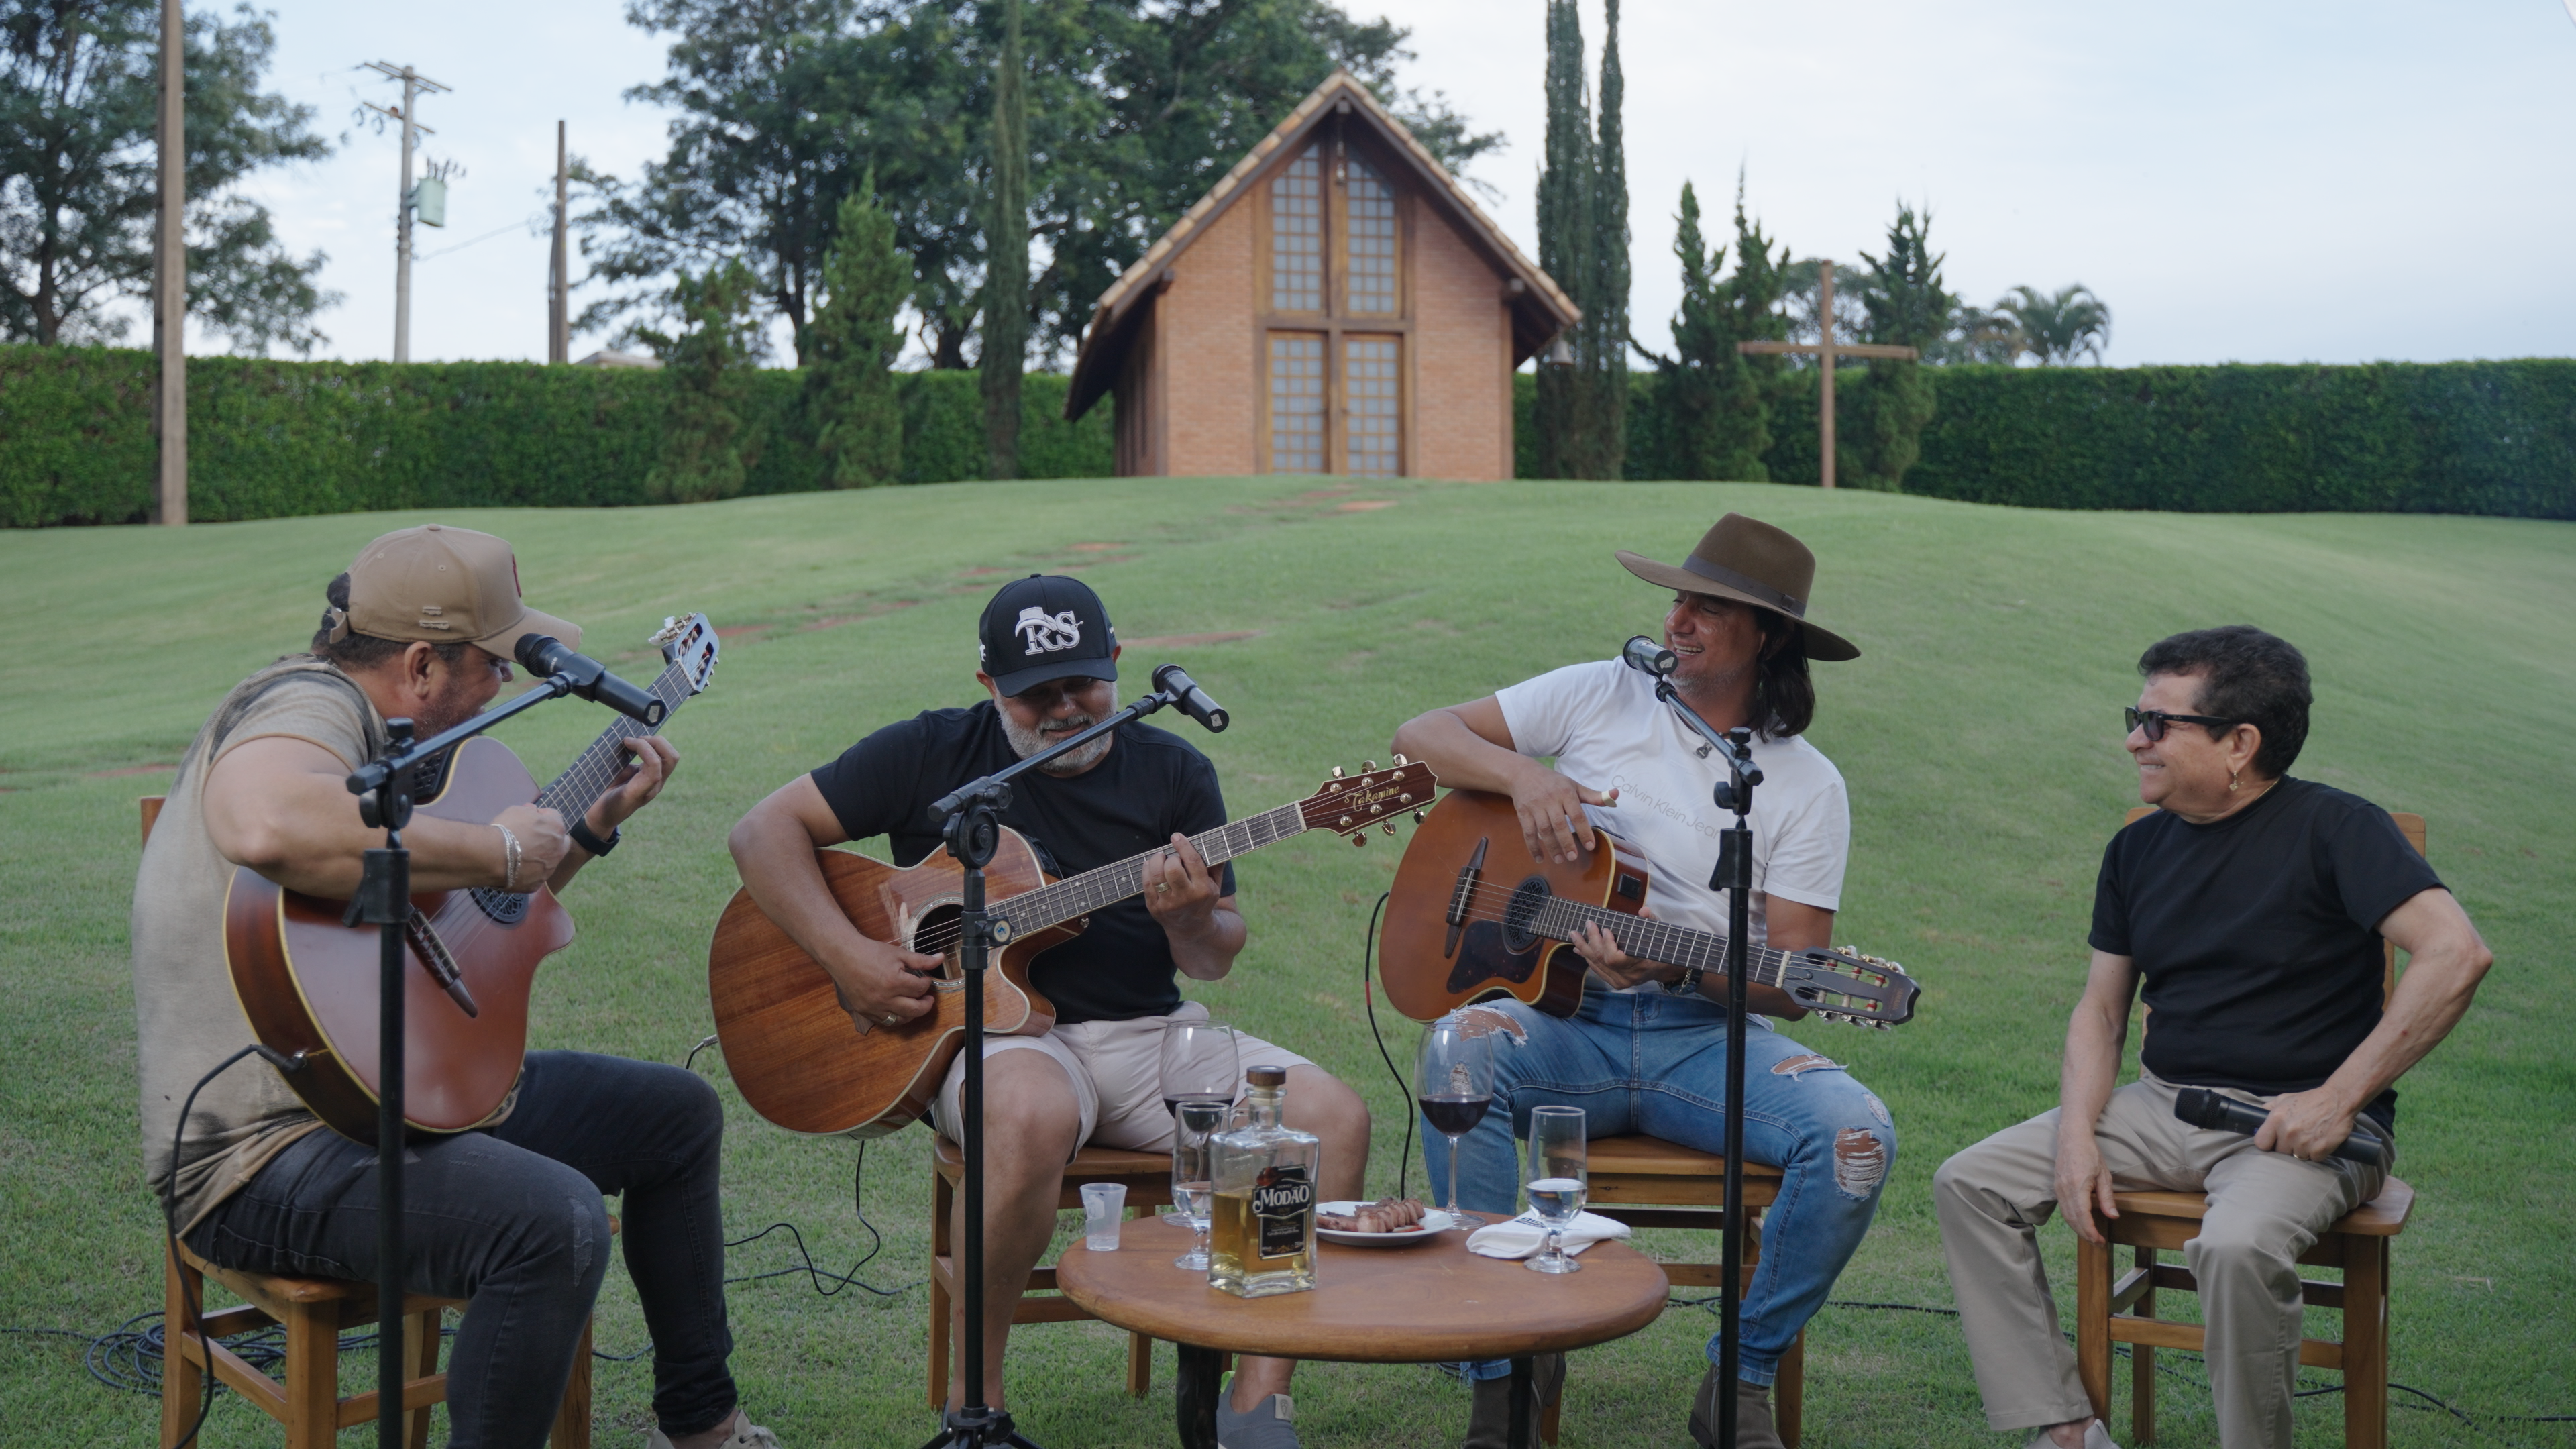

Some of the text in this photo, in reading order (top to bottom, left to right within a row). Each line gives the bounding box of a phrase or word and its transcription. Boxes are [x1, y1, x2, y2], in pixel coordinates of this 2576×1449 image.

[1024, 610, 1081, 655] RS
[1344, 786, 1400, 812] Takamine
[1611, 775, 1653, 806] Calvin
[1653, 798, 1686, 824] Klein
